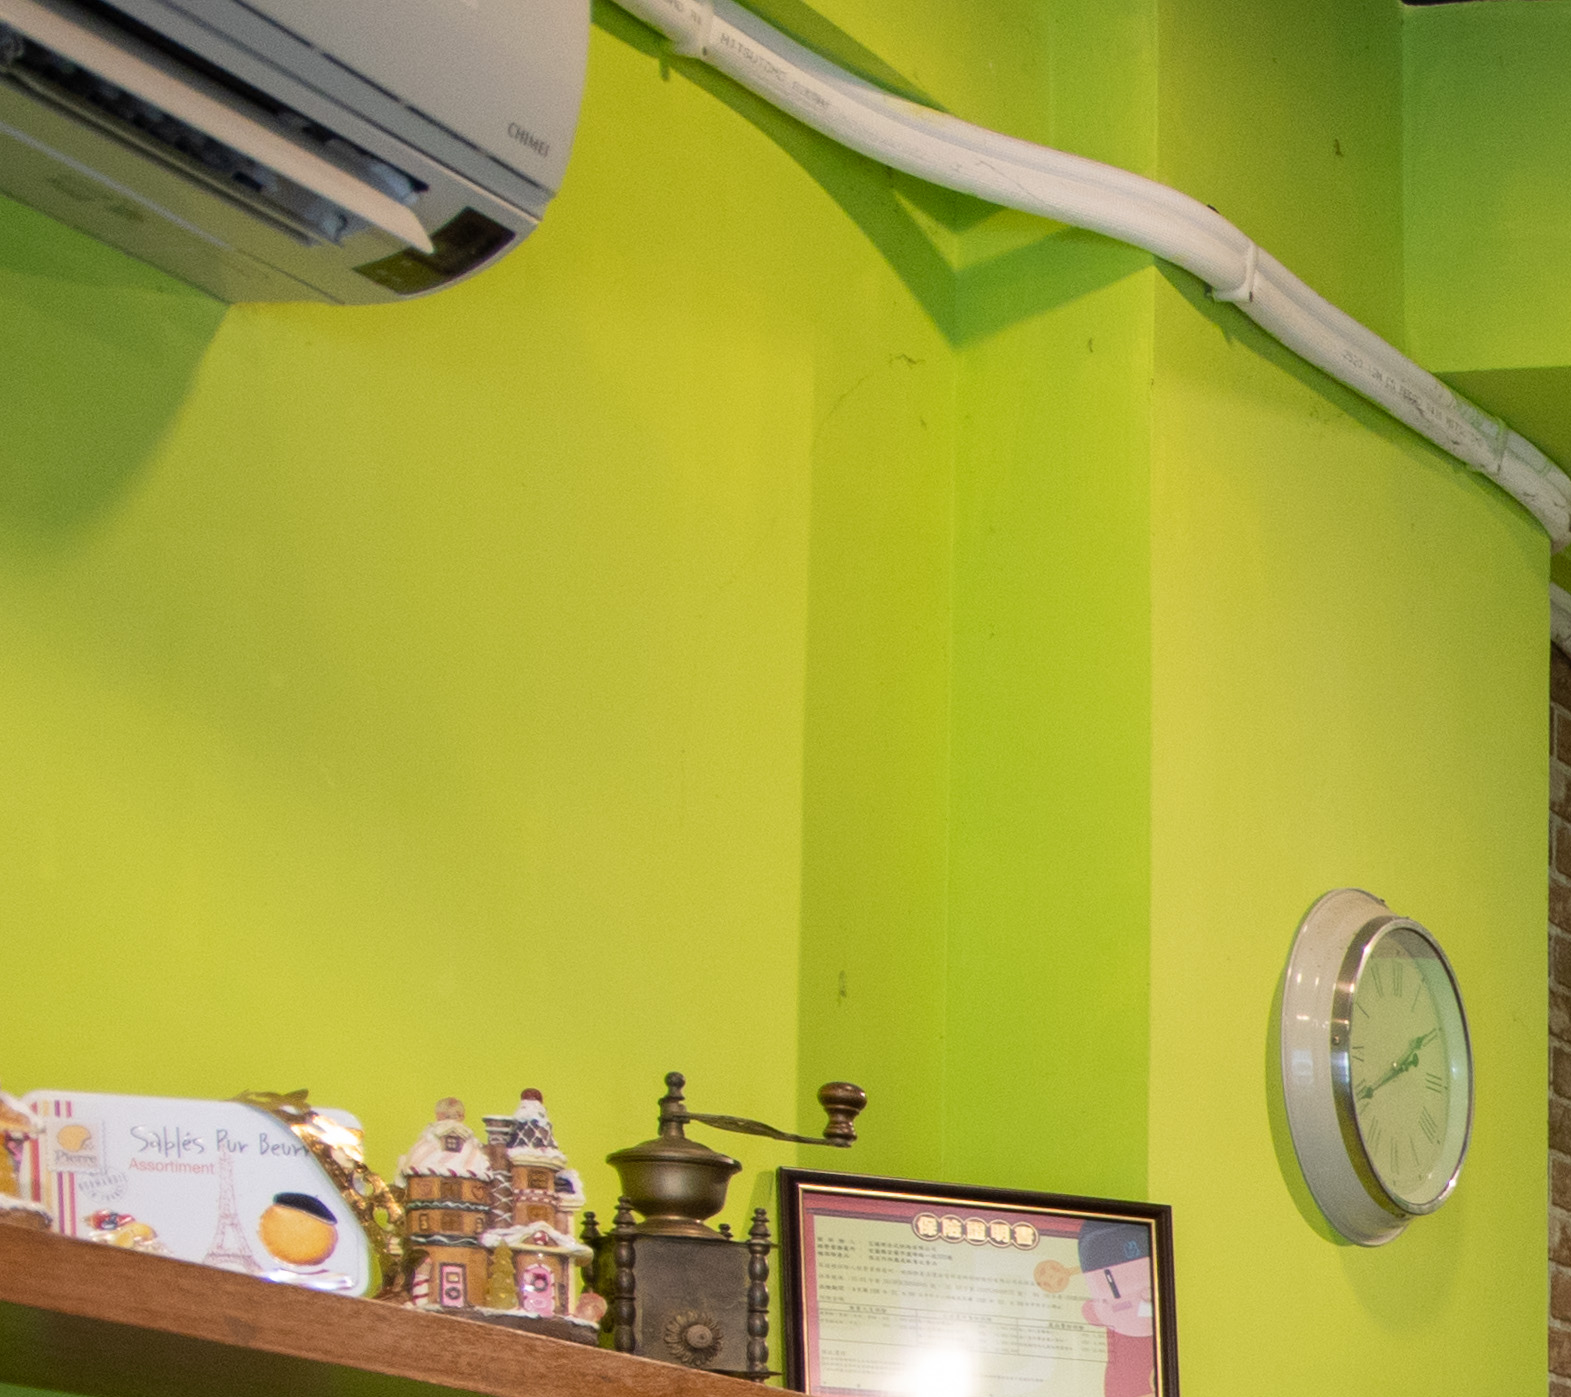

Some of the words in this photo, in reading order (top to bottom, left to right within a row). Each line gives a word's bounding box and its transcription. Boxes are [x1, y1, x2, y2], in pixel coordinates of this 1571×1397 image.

[130, 1124, 205, 1156] Sablés
[216, 1128, 249, 1153] Pur
[128, 1157, 215, 1175] Assortiment
[915, 1213, 1037, 1247] 保險證明書
